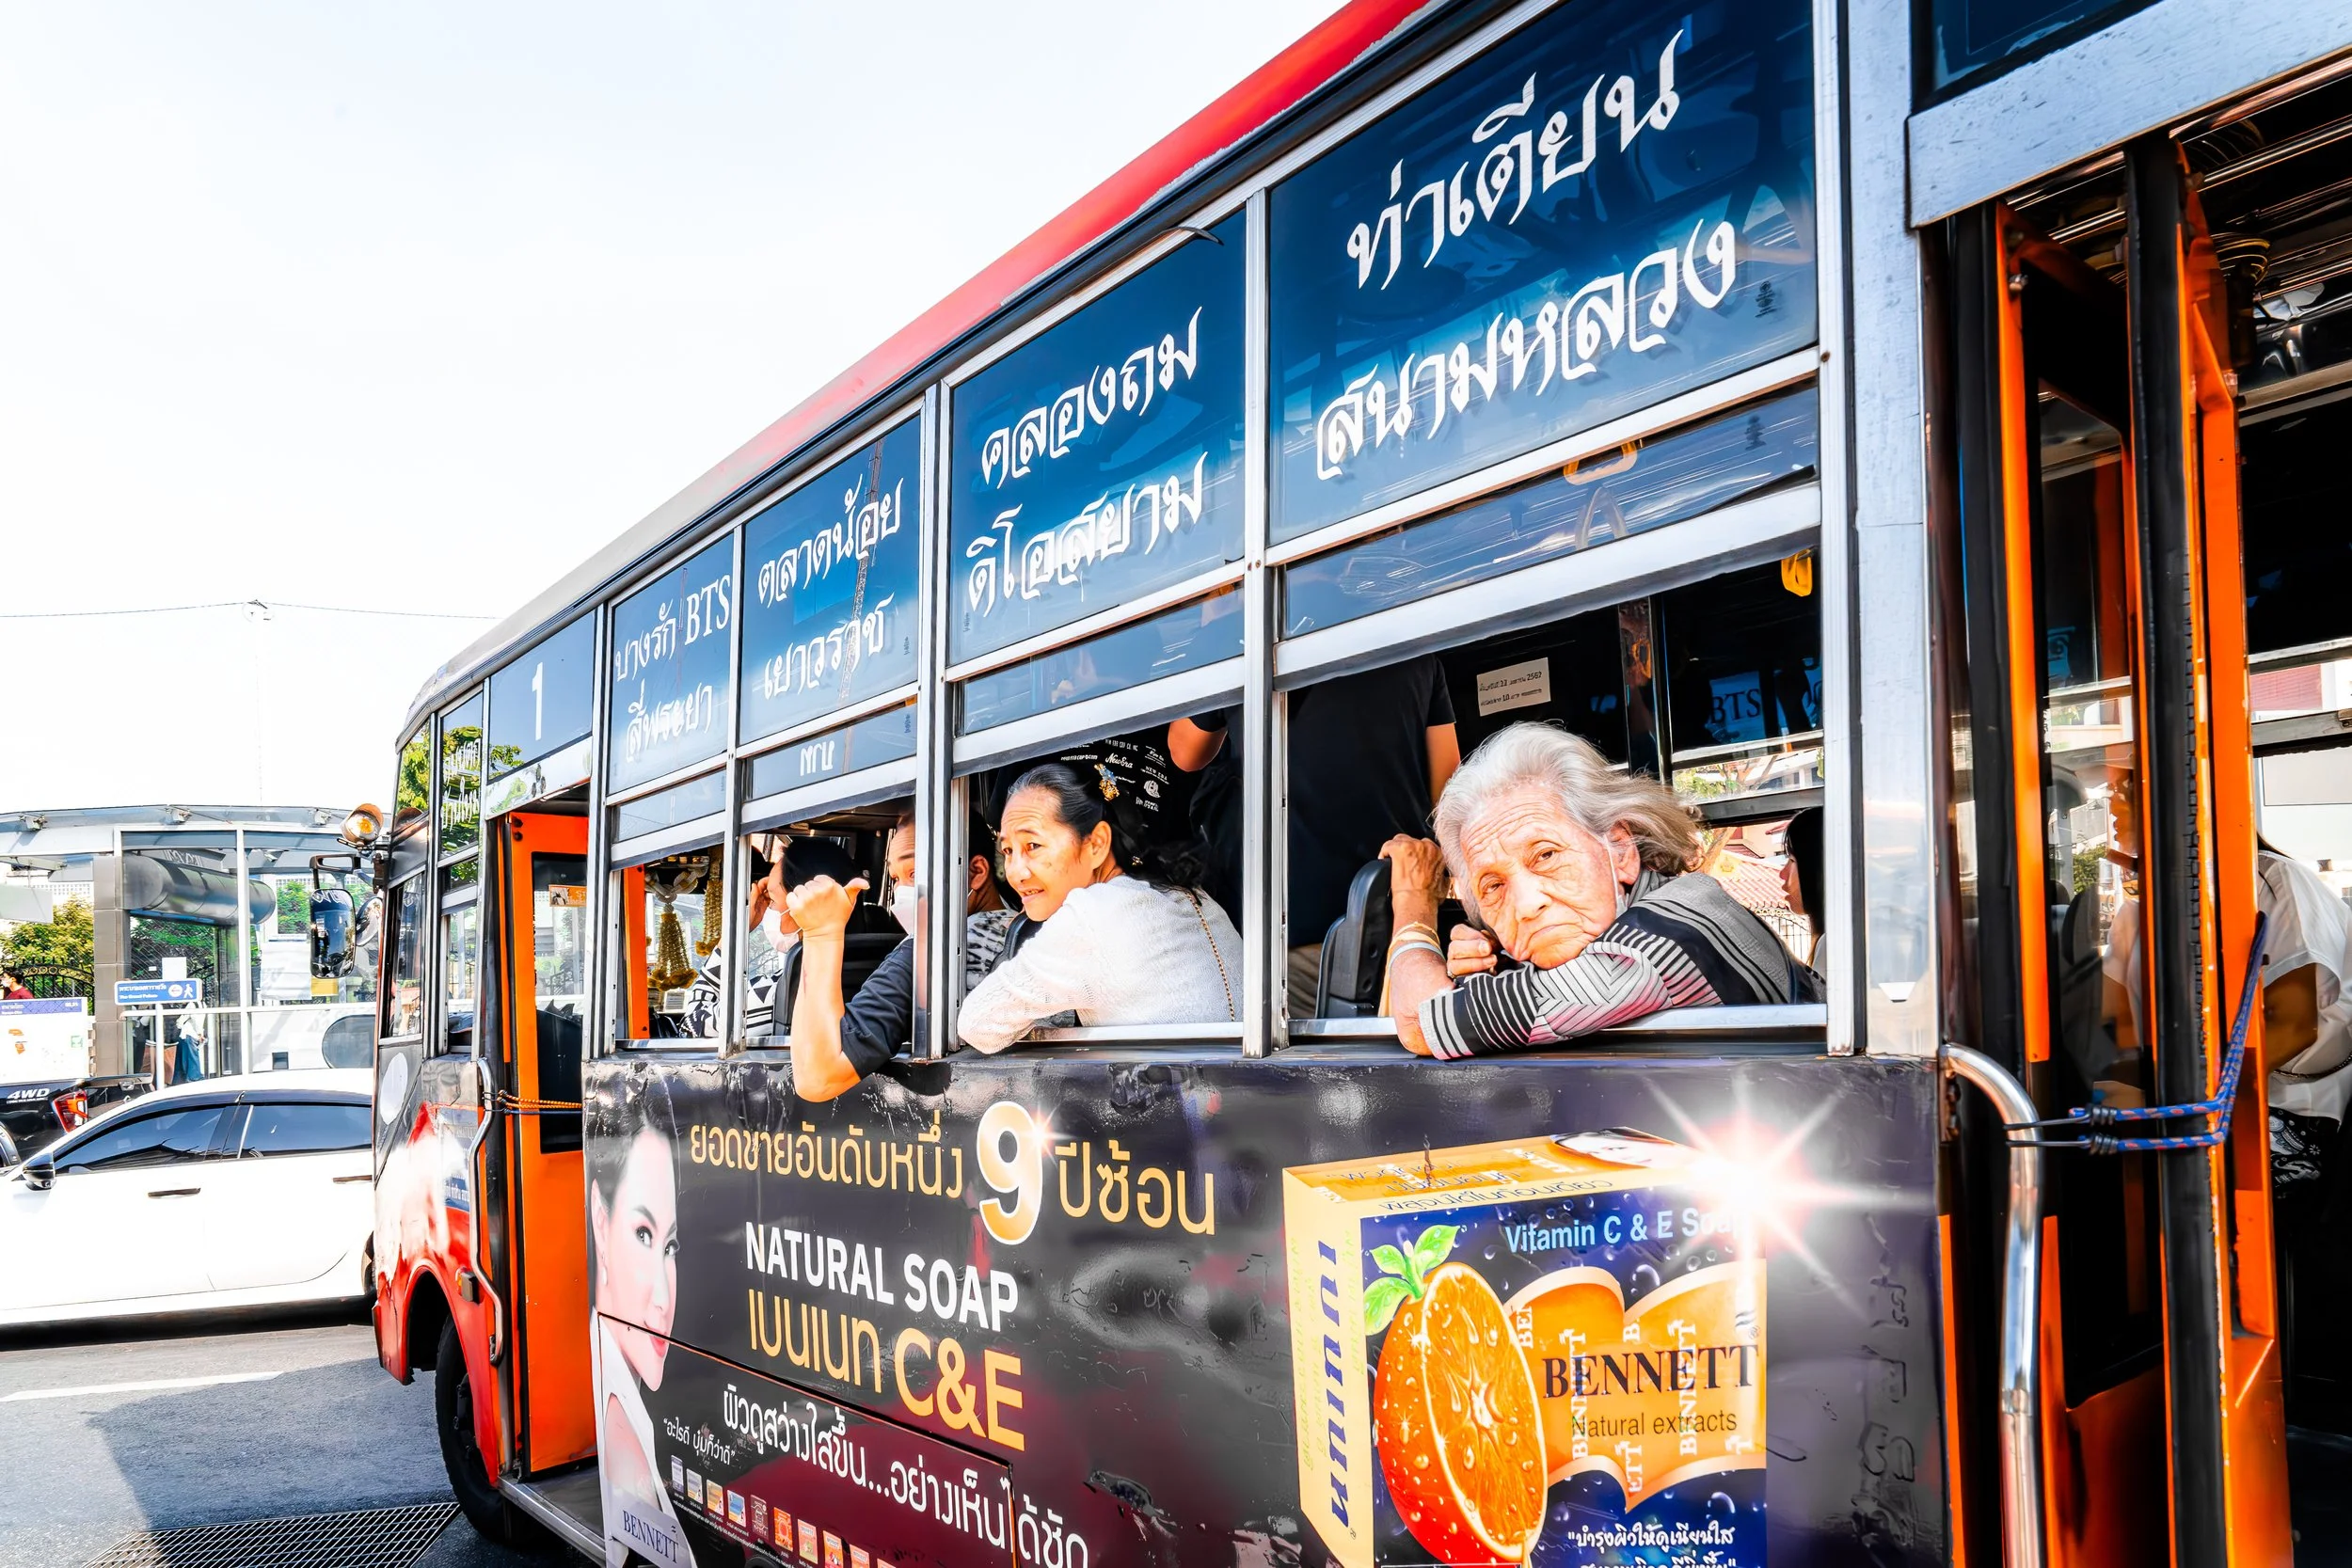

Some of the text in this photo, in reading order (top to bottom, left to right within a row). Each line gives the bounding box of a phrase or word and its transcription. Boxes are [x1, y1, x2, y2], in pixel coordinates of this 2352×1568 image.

[1346, 29, 1685, 290] ท่าเตียน
[981, 307, 1202, 489] คลองถม
[1317, 218, 1737, 481] สนามหลวง
[758, 474, 904, 608] ตลาดน้อย
[966, 451, 1208, 617] ดิโอสยาม
[615, 575, 731, 682] บางรัก BTS
[765, 592, 895, 700] เยาวราช
[532, 661, 543, 740] 1
[627, 678, 713, 763] สี่พระยา
[1711, 689, 1760, 724] BTS
[7, 1088, 50, 1100] 4WD
[691, 1101, 1216, 1245] ยอดขายอันดับหนึ่ง 9 ปีซ้อน
[746, 1221, 1019, 1332] NATURAL SOAP
[1505, 1219, 1596, 1254] Vitamin
[1603, 1216, 1622, 1243] C
[1629, 1213, 1648, 1242] &
[1657, 1211, 1674, 1239] E
[748, 1289, 1025, 1451] เบนเนท C&E
[1542, 1344, 1758, 1399] BENNETT
[1572, 1410, 1738, 1437] Natural extracts
[623, 1510, 678, 1563] BENNETT
